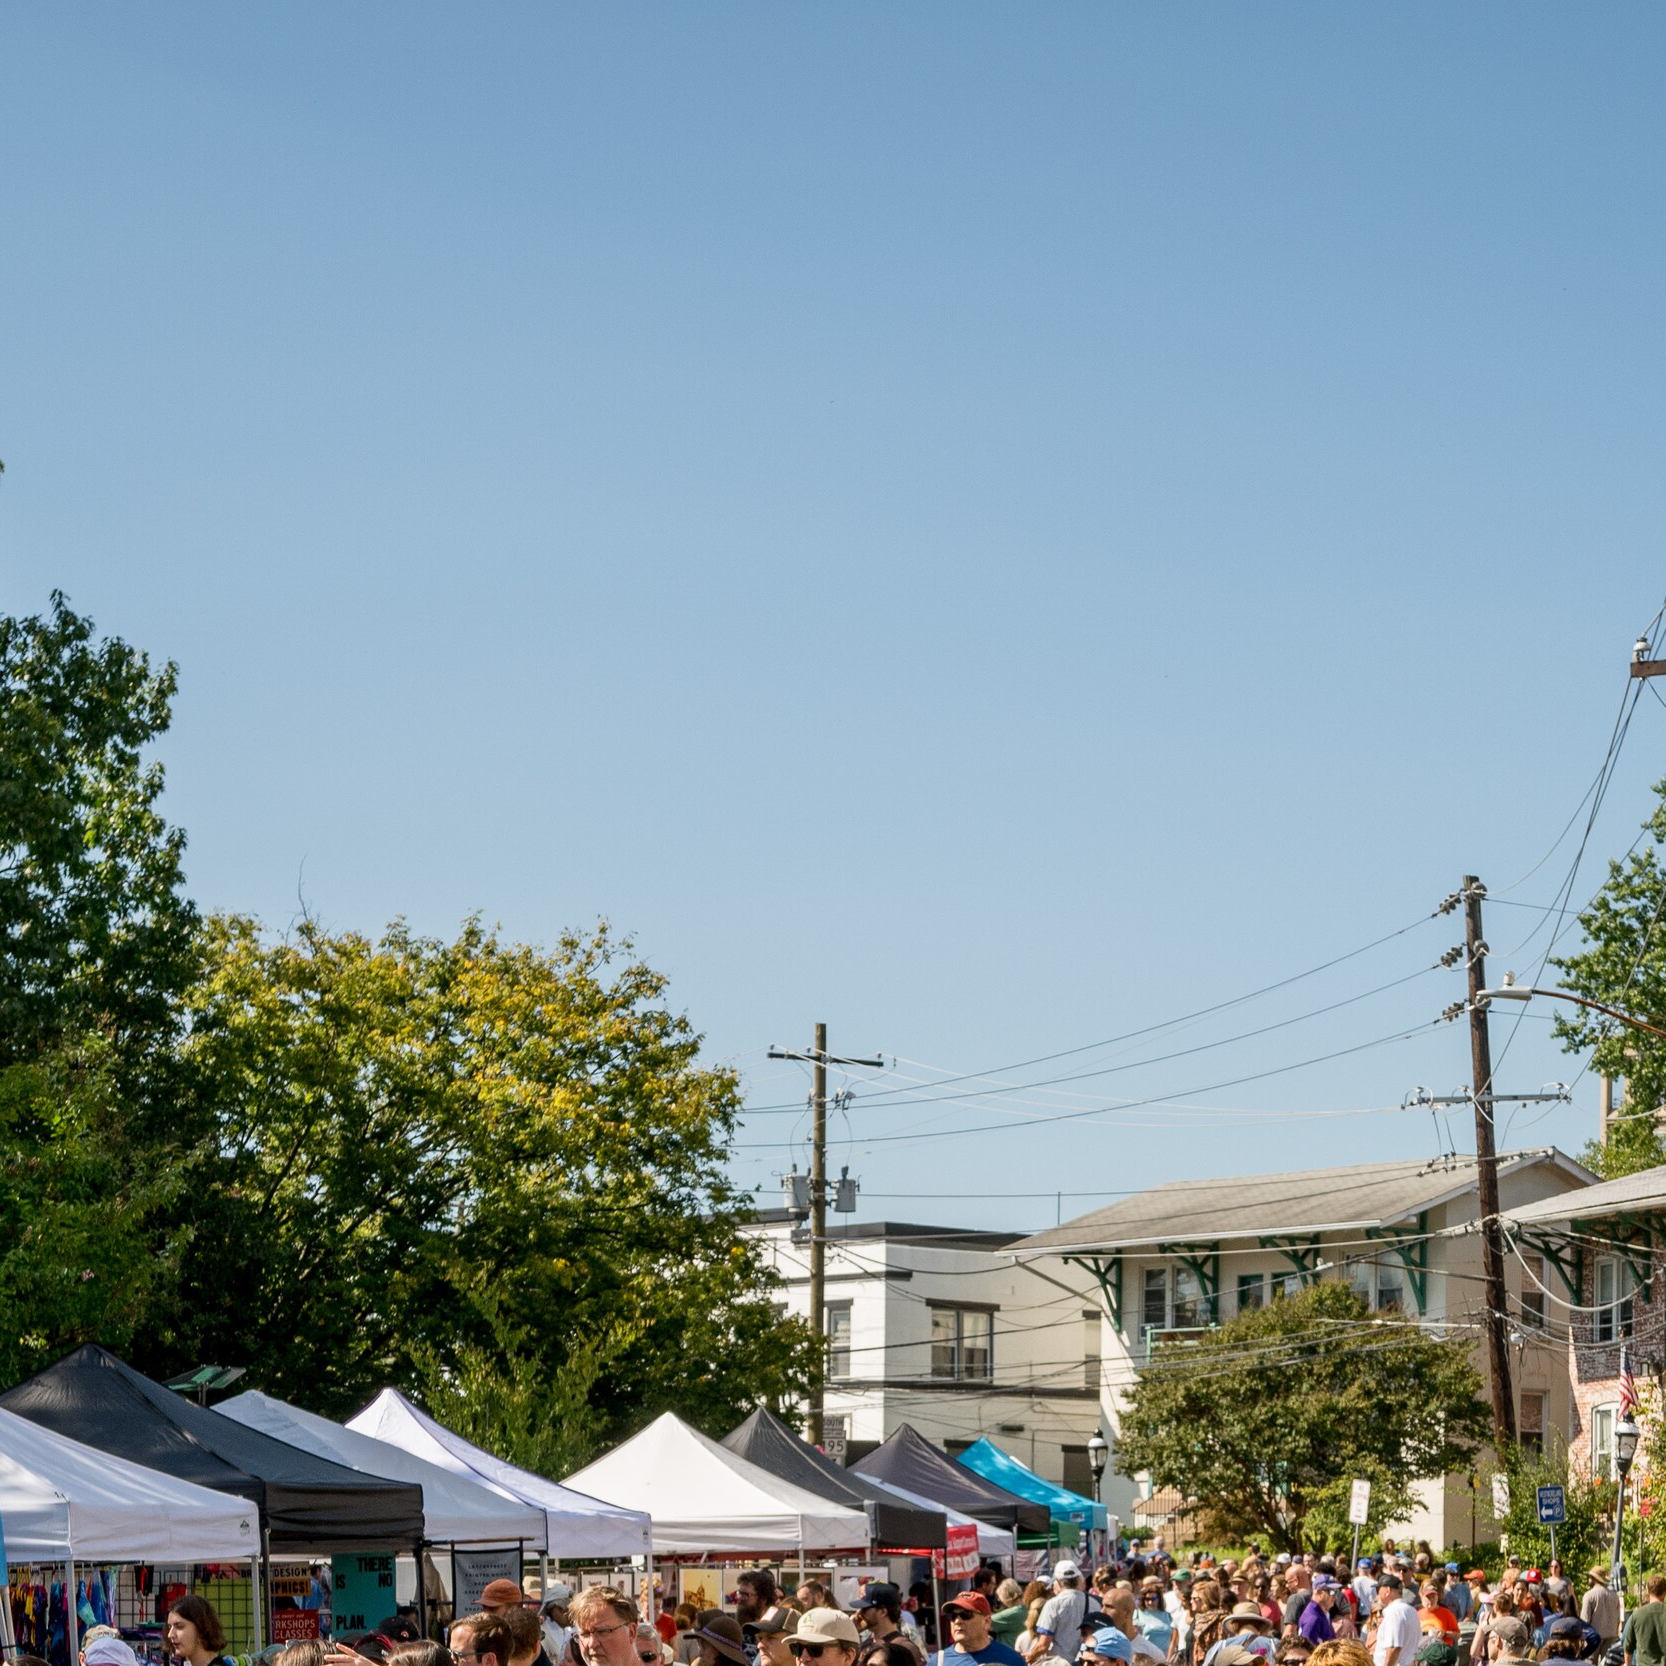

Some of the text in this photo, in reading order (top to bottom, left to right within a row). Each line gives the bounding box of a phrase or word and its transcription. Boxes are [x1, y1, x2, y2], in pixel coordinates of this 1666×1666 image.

[274, 1567, 308, 1577] DESIGN
[356, 1557, 393, 1572] THERE
[335, 1573, 393, 1590] IS NO
[275, 1619, 316, 1630] RKSHOPS
[336, 1615, 368, 1630] PLAN.
